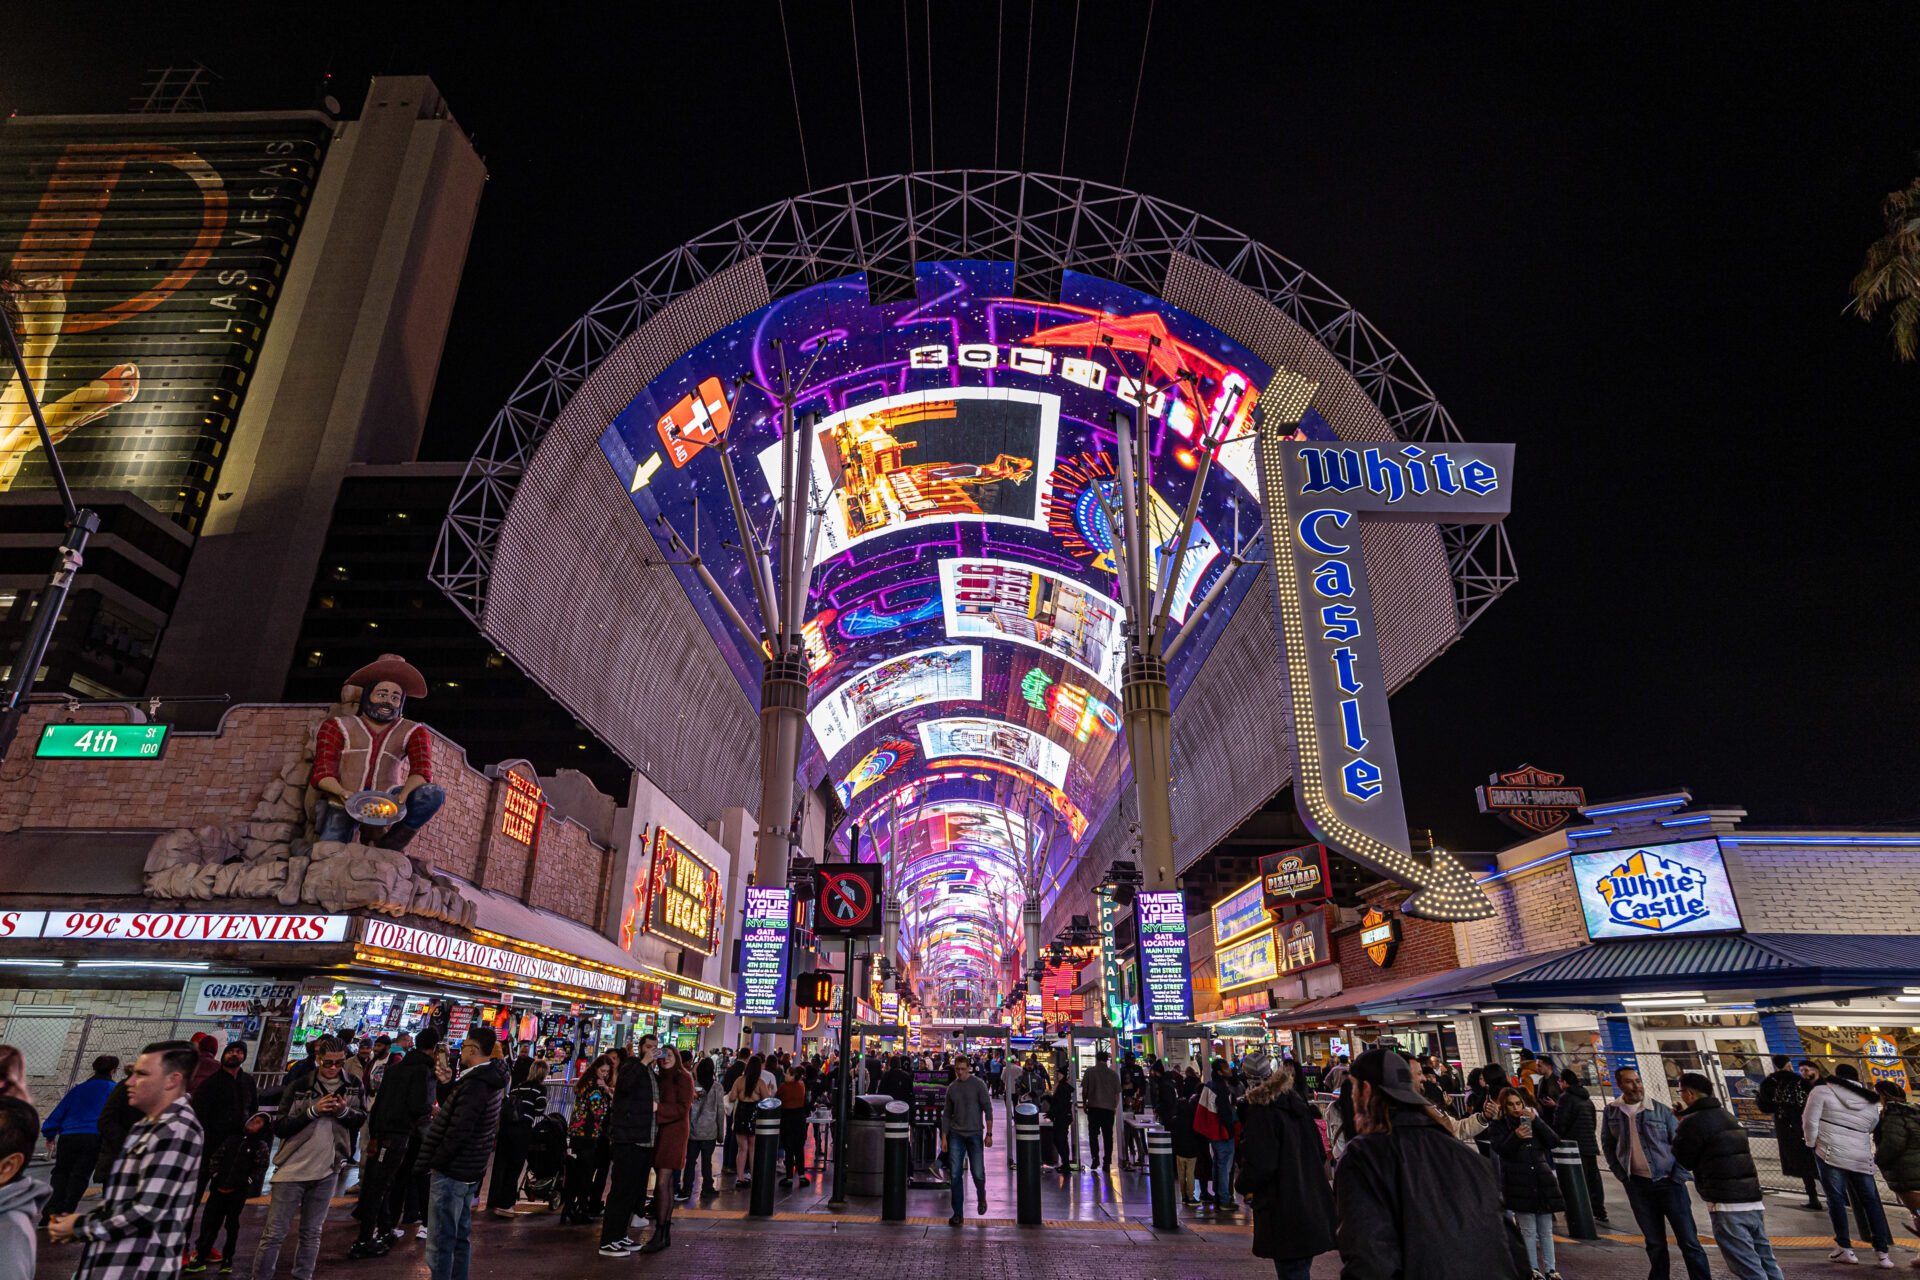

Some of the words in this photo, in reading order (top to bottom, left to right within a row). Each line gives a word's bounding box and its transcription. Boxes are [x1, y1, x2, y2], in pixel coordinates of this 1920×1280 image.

[197, 269, 248, 333] LAS
[231, 142, 294, 246] VEGAS
[674, 444, 688, 463] AID
[1297, 445, 1499, 503] White
[1296, 508, 1383, 802] Castle
[46, 727, 55, 737] N
[74, 730, 118, 753] 4th
[145, 728, 157, 738] St
[140, 743, 158, 754] 100
[504, 787, 539, 824] WESTERN
[1491, 789, 1581, 805] HARLEY-DAVIDSON
[501, 810, 533, 845] VILLAGE
[676, 851, 705, 901] VIVA
[1268, 873, 1297, 890] PIZZA
[1297, 869, 1317, 884] BAR
[1609, 871, 1695, 900] White
[665, 886, 708, 939] VEGAS
[747, 899, 789, 909] YOUR
[747, 909, 788, 918] LIFE
[1140, 904, 1183, 913] YOUR
[1610, 894, 1705, 921] Castle
[63, 912, 121, 938] 99¢
[125, 913, 329, 940] SOUVENIRS
[1141, 914, 1184, 923] LIFE
[370, 920, 448, 959] TOBACCO
[1103, 907, 1116, 991] PORTAL
[558, 966, 606, 990] SOUVENIRS
[606, 976, 626, 995] BEER
[203, 983, 258, 999] COLDEST
[260, 985, 296, 998] BEER
[678, 984, 692, 997] HATS
[694, 988, 714, 1003] LIQUOR
[207, 1000, 220, 1011] IN
[221, 1000, 249, 1012] TOWN
[684, 1016, 712, 1025] LIQUOR
[677, 1040, 696, 1048] VAPE
[1821, 1031, 1839, 1039] LAS
[1871, 1067, 1905, 1079] Open
